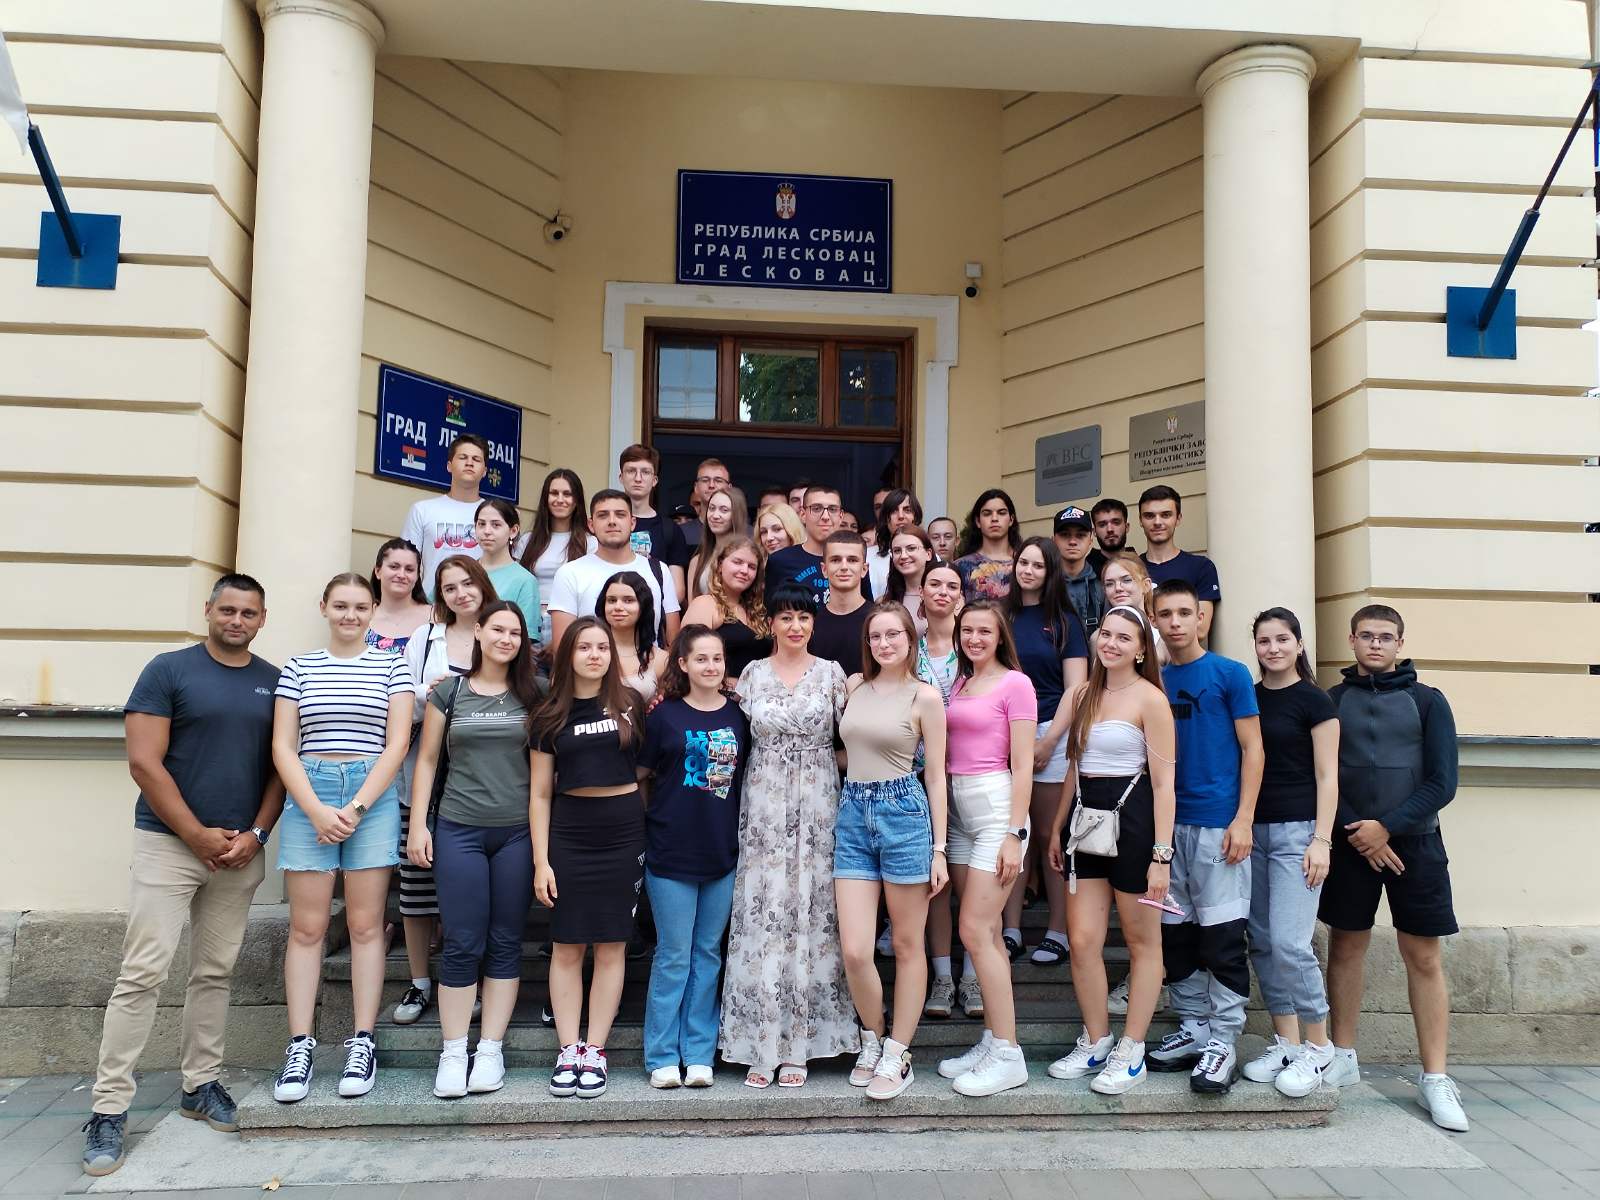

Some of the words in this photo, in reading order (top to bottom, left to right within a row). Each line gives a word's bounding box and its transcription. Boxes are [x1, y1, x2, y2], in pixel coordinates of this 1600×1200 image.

[694, 223, 800, 240] РЕПУБЛИКА
[809, 228, 875, 243] СРБИЈА
[694, 244, 747, 260] ГРАД
[762, 247, 875, 265] ЛЕСКОВАЦ
[693, 263, 875, 285] ЛЕСКОВАЦ
[386, 412, 427, 446] ГРАД
[438, 427, 514, 469] ЛЕВАЦ
[574, 719, 619, 736] PUM
